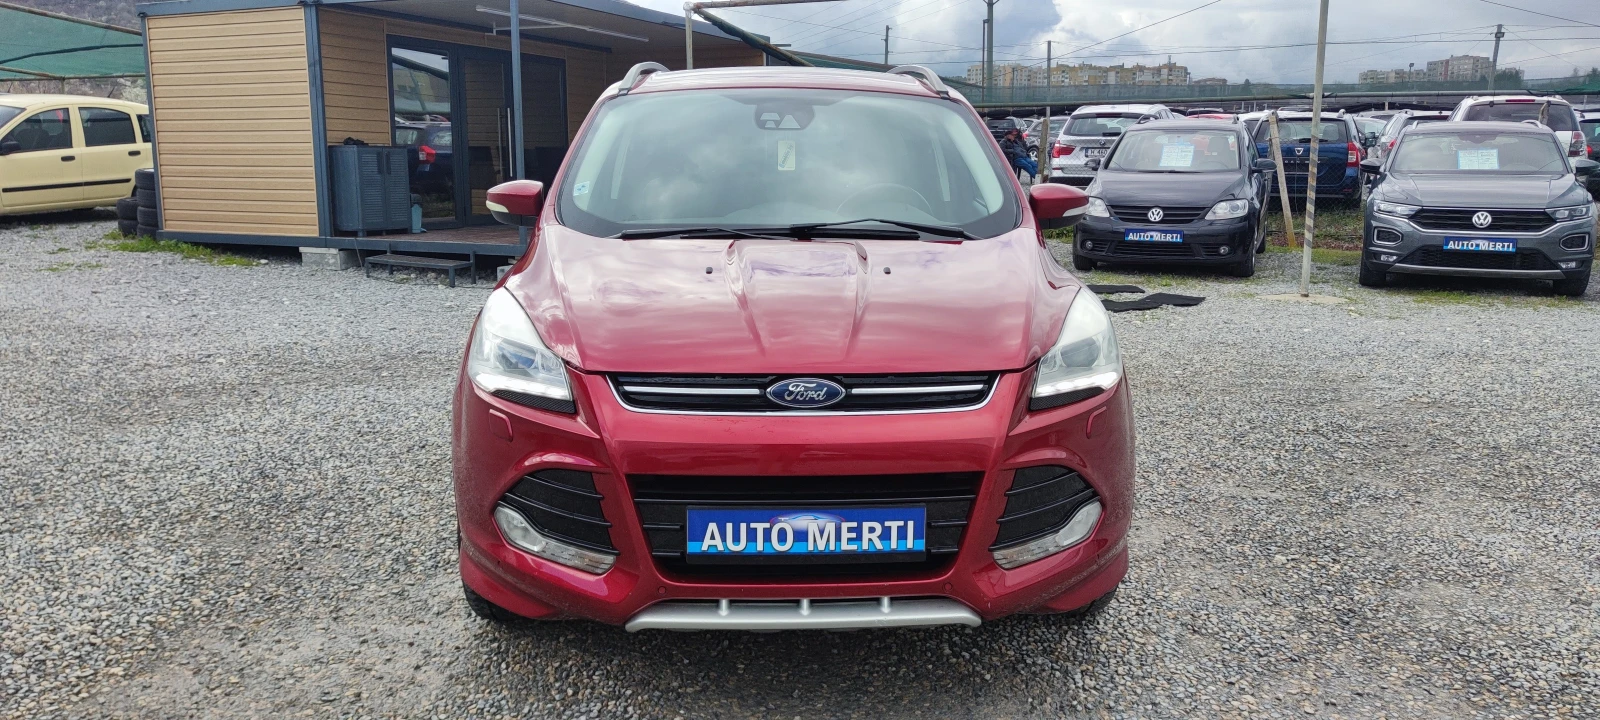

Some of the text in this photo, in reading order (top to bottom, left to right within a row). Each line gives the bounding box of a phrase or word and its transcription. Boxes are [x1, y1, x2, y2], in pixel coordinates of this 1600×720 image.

[1127, 232, 1181, 242] AUTO MERTI
[1447, 240, 1513, 252] AUTO MERTI
[784, 382, 827, 401] Ford
[700, 520, 915, 552] AUTO MERTI
